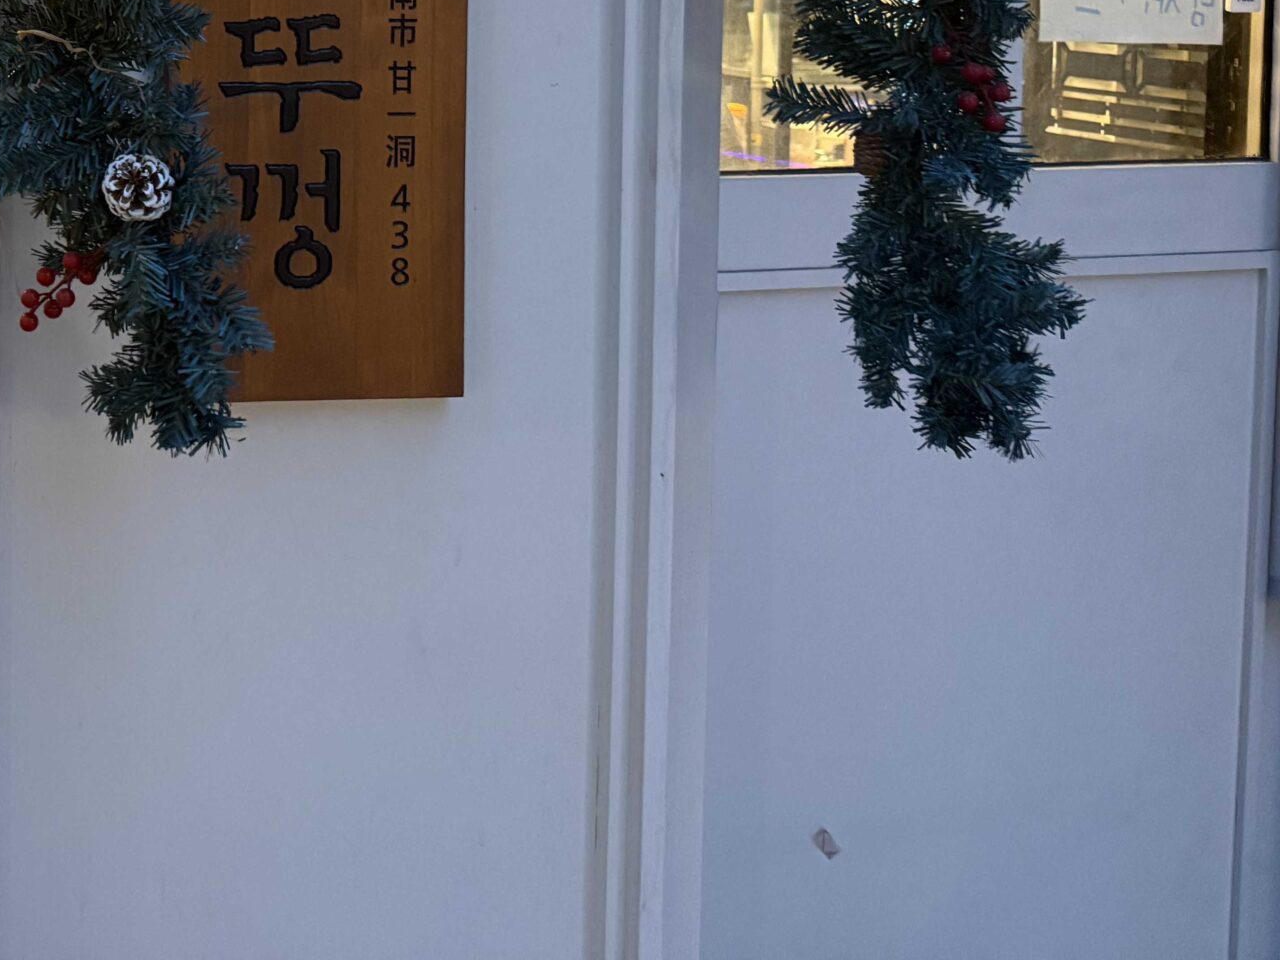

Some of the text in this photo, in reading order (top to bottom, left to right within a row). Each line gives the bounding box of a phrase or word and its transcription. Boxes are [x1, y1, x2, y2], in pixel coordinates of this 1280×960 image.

[384, 59, 418, 169] 甘一洞
[389, 184, 412, 288] 438
